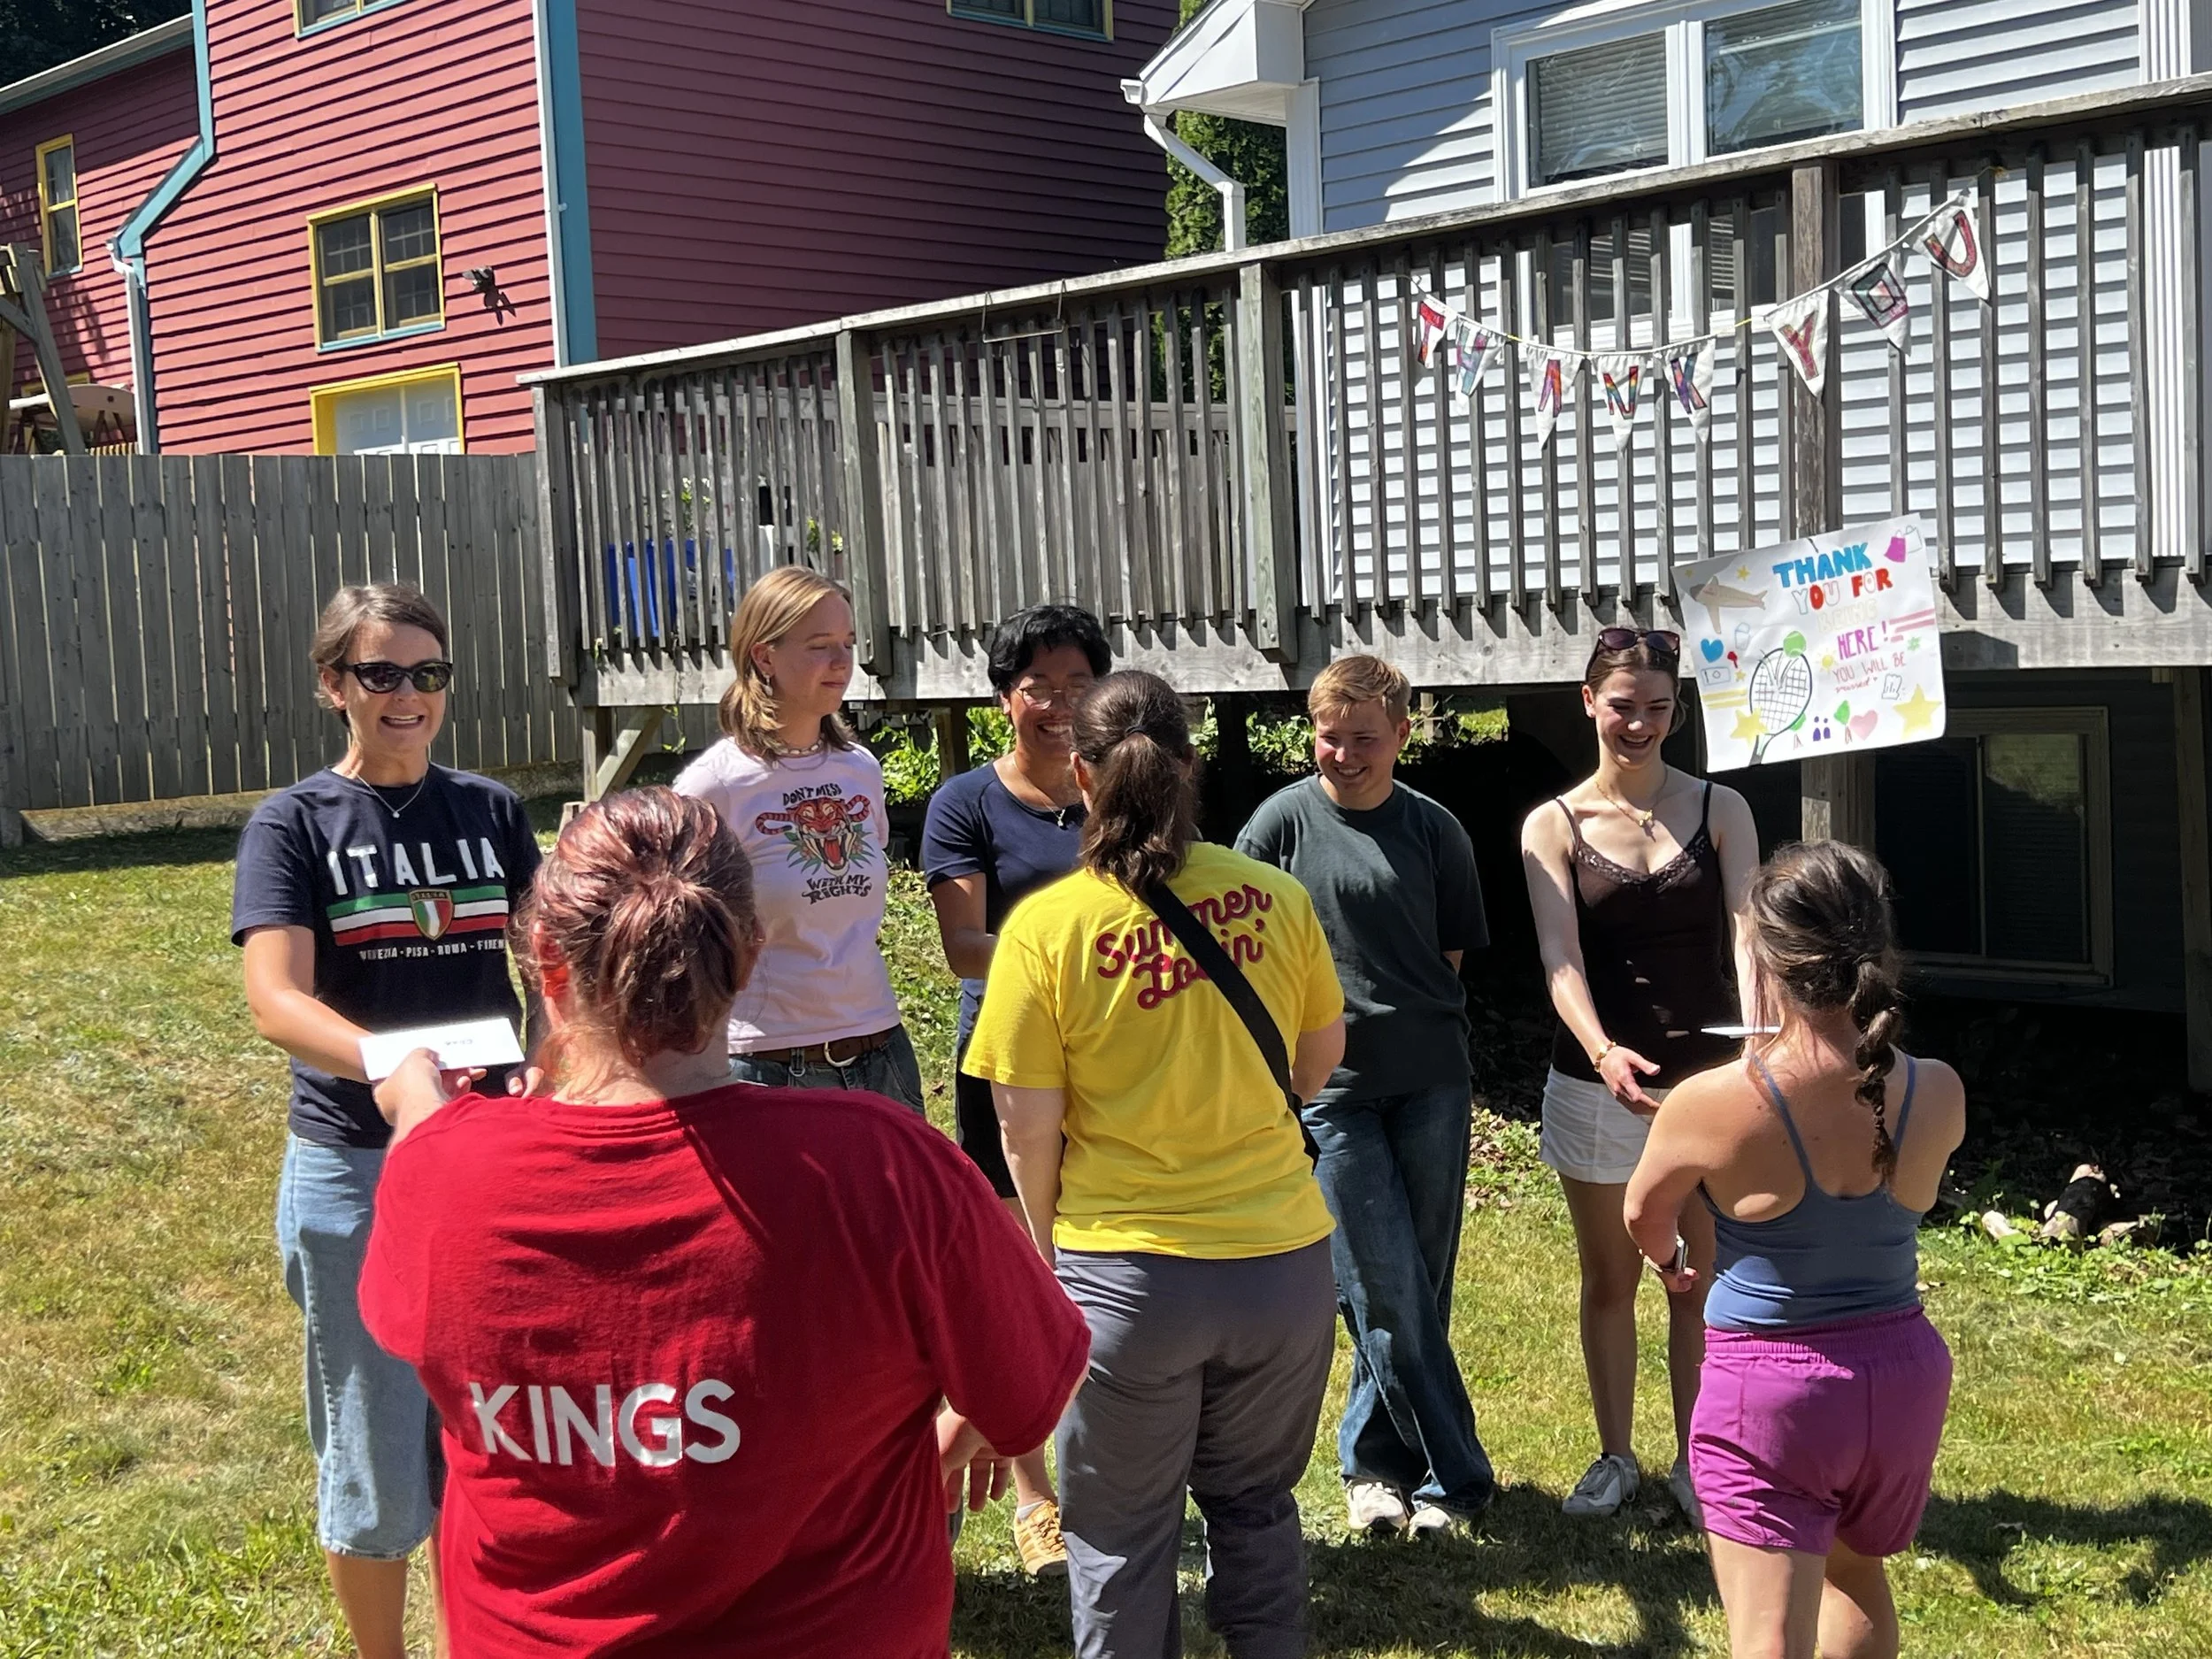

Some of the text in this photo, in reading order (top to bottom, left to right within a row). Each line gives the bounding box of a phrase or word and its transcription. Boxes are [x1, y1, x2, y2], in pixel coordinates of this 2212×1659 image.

[1418, 210, 1978, 419] THANK YOU
[1772, 542, 1872, 588] THANK
[1791, 568, 1893, 615] YOU FOR
[1832, 651, 1906, 683] YOU WILL BE
[782, 783, 842, 806] DON'T MESS
[327, 837, 505, 895] ITALIA
[846, 874, 871, 886] MY
[359, 947, 398, 961] VENEZIA
[406, 947, 429, 957] PISA
[437, 942, 467, 956] ROMA
[477, 939, 505, 950] FIREN
[469, 1379, 741, 1467] KINGS
